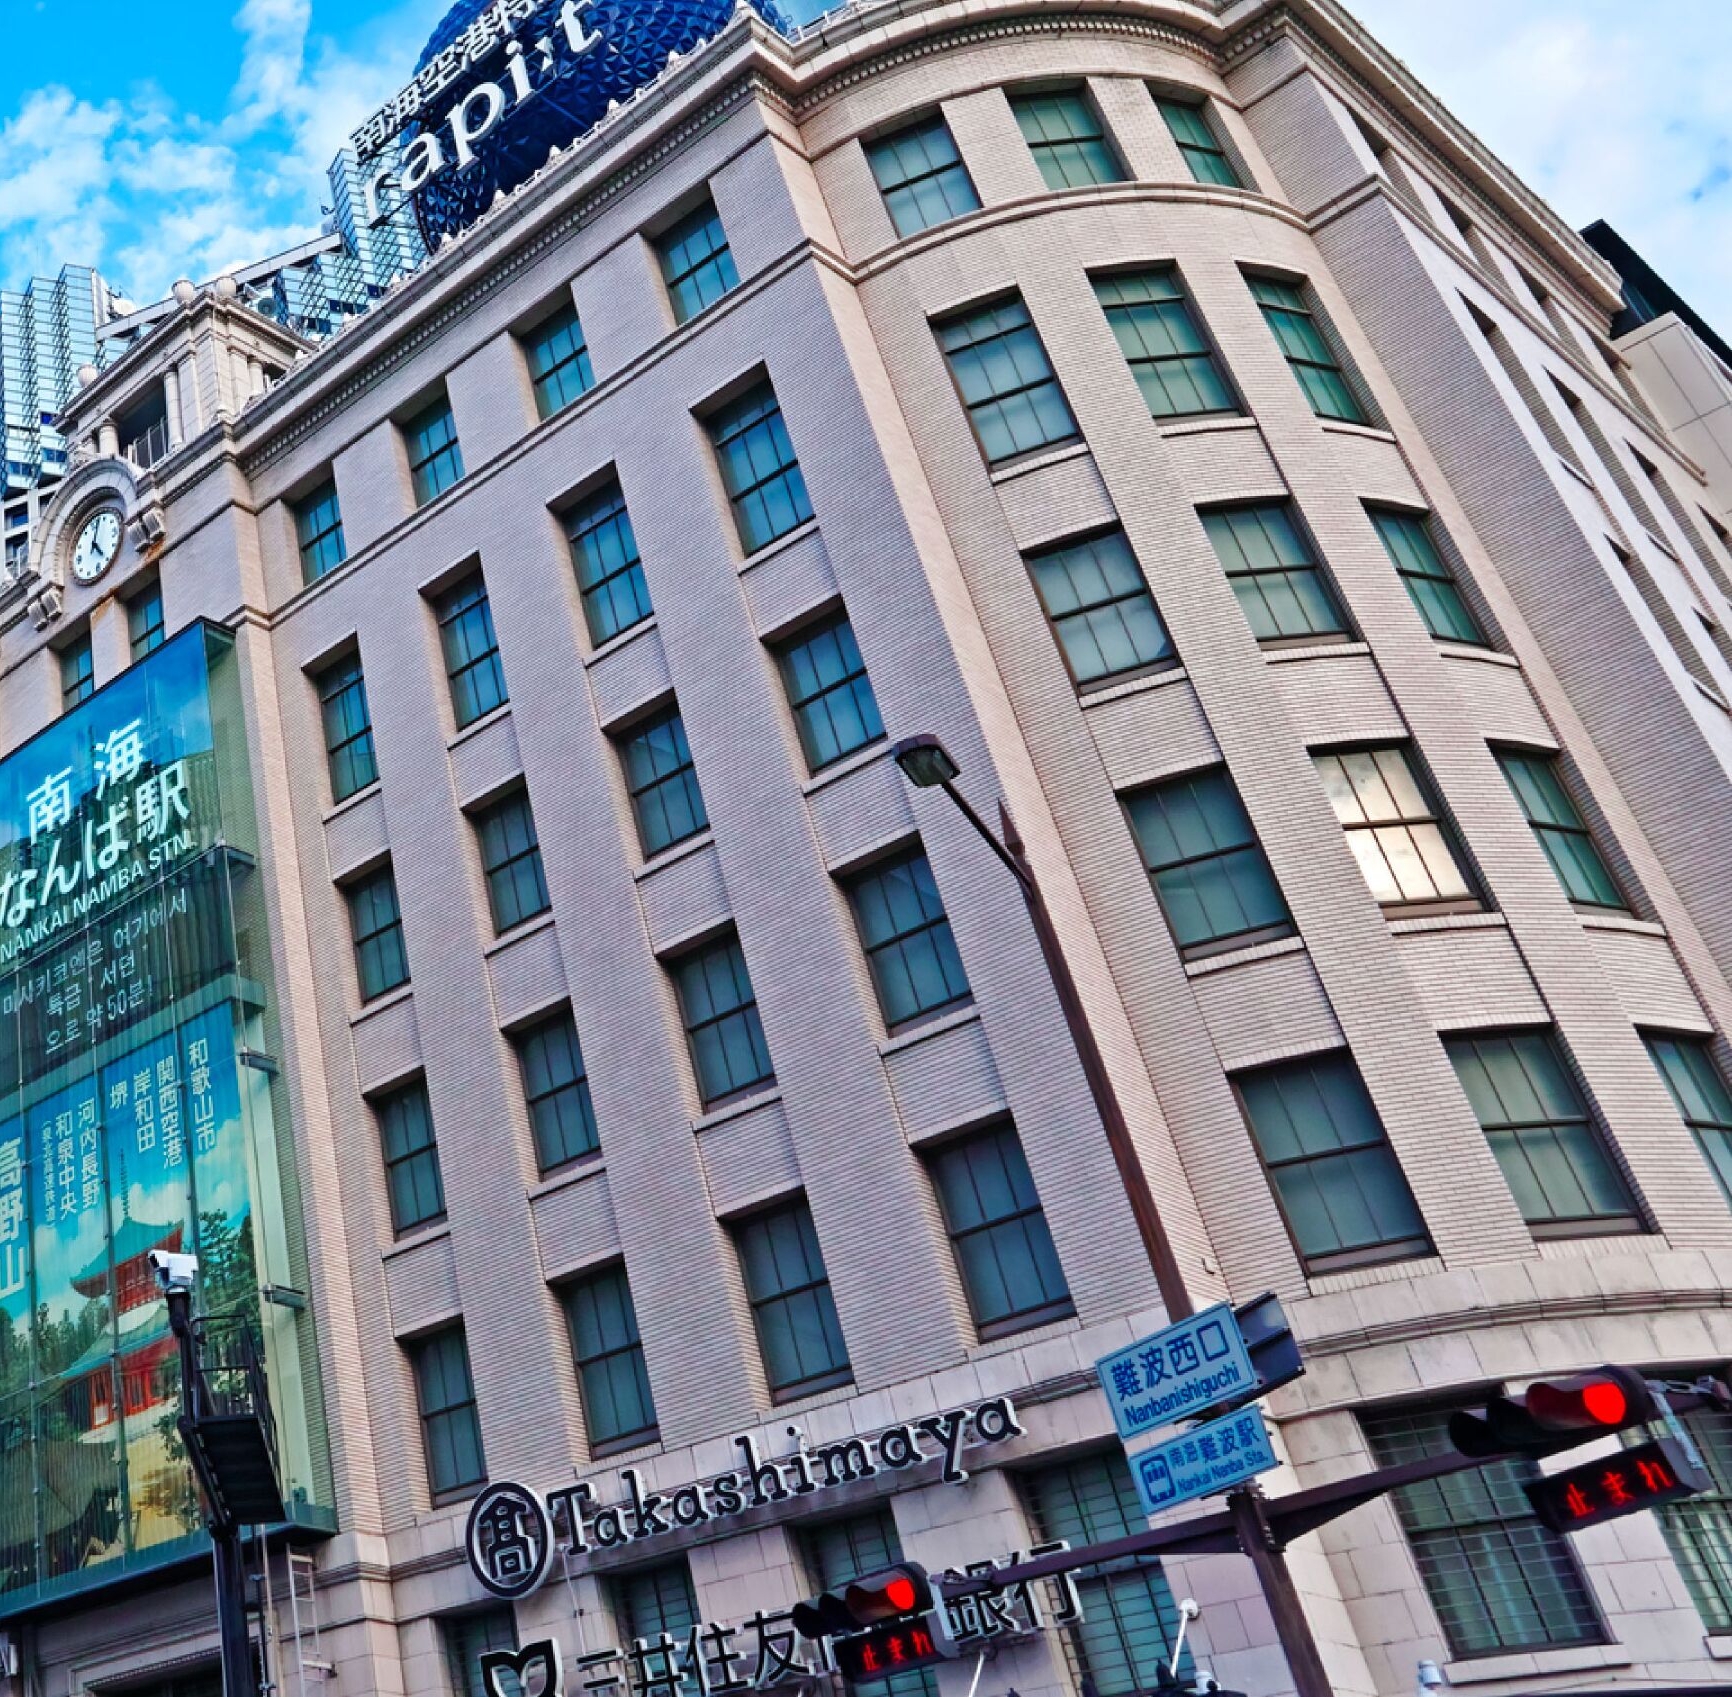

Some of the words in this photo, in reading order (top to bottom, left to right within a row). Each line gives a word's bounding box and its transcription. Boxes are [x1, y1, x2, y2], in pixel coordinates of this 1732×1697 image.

[26, 718, 144, 846] 南海
[0, 910, 70, 962] NANKAI
[73, 859, 144, 917] NAMBA
[148, 828, 197, 870] STN.
[133, 1067, 156, 1153] 岸和田
[156, 1055, 183, 1169] 関西空港
[188, 1037, 216, 1151] 和歌山市
[55, 1109, 76, 1221] 和泉中央
[78, 1097, 100, 1209] 河内長野
[1111, 1320, 1231, 1400] 難波西口
[1124, 1361, 1242, 1427] Nanbanishiguchi
[547, 1397, 1028, 1557] Takashimaya
[1566, 1460, 1675, 1519] 止まれ
